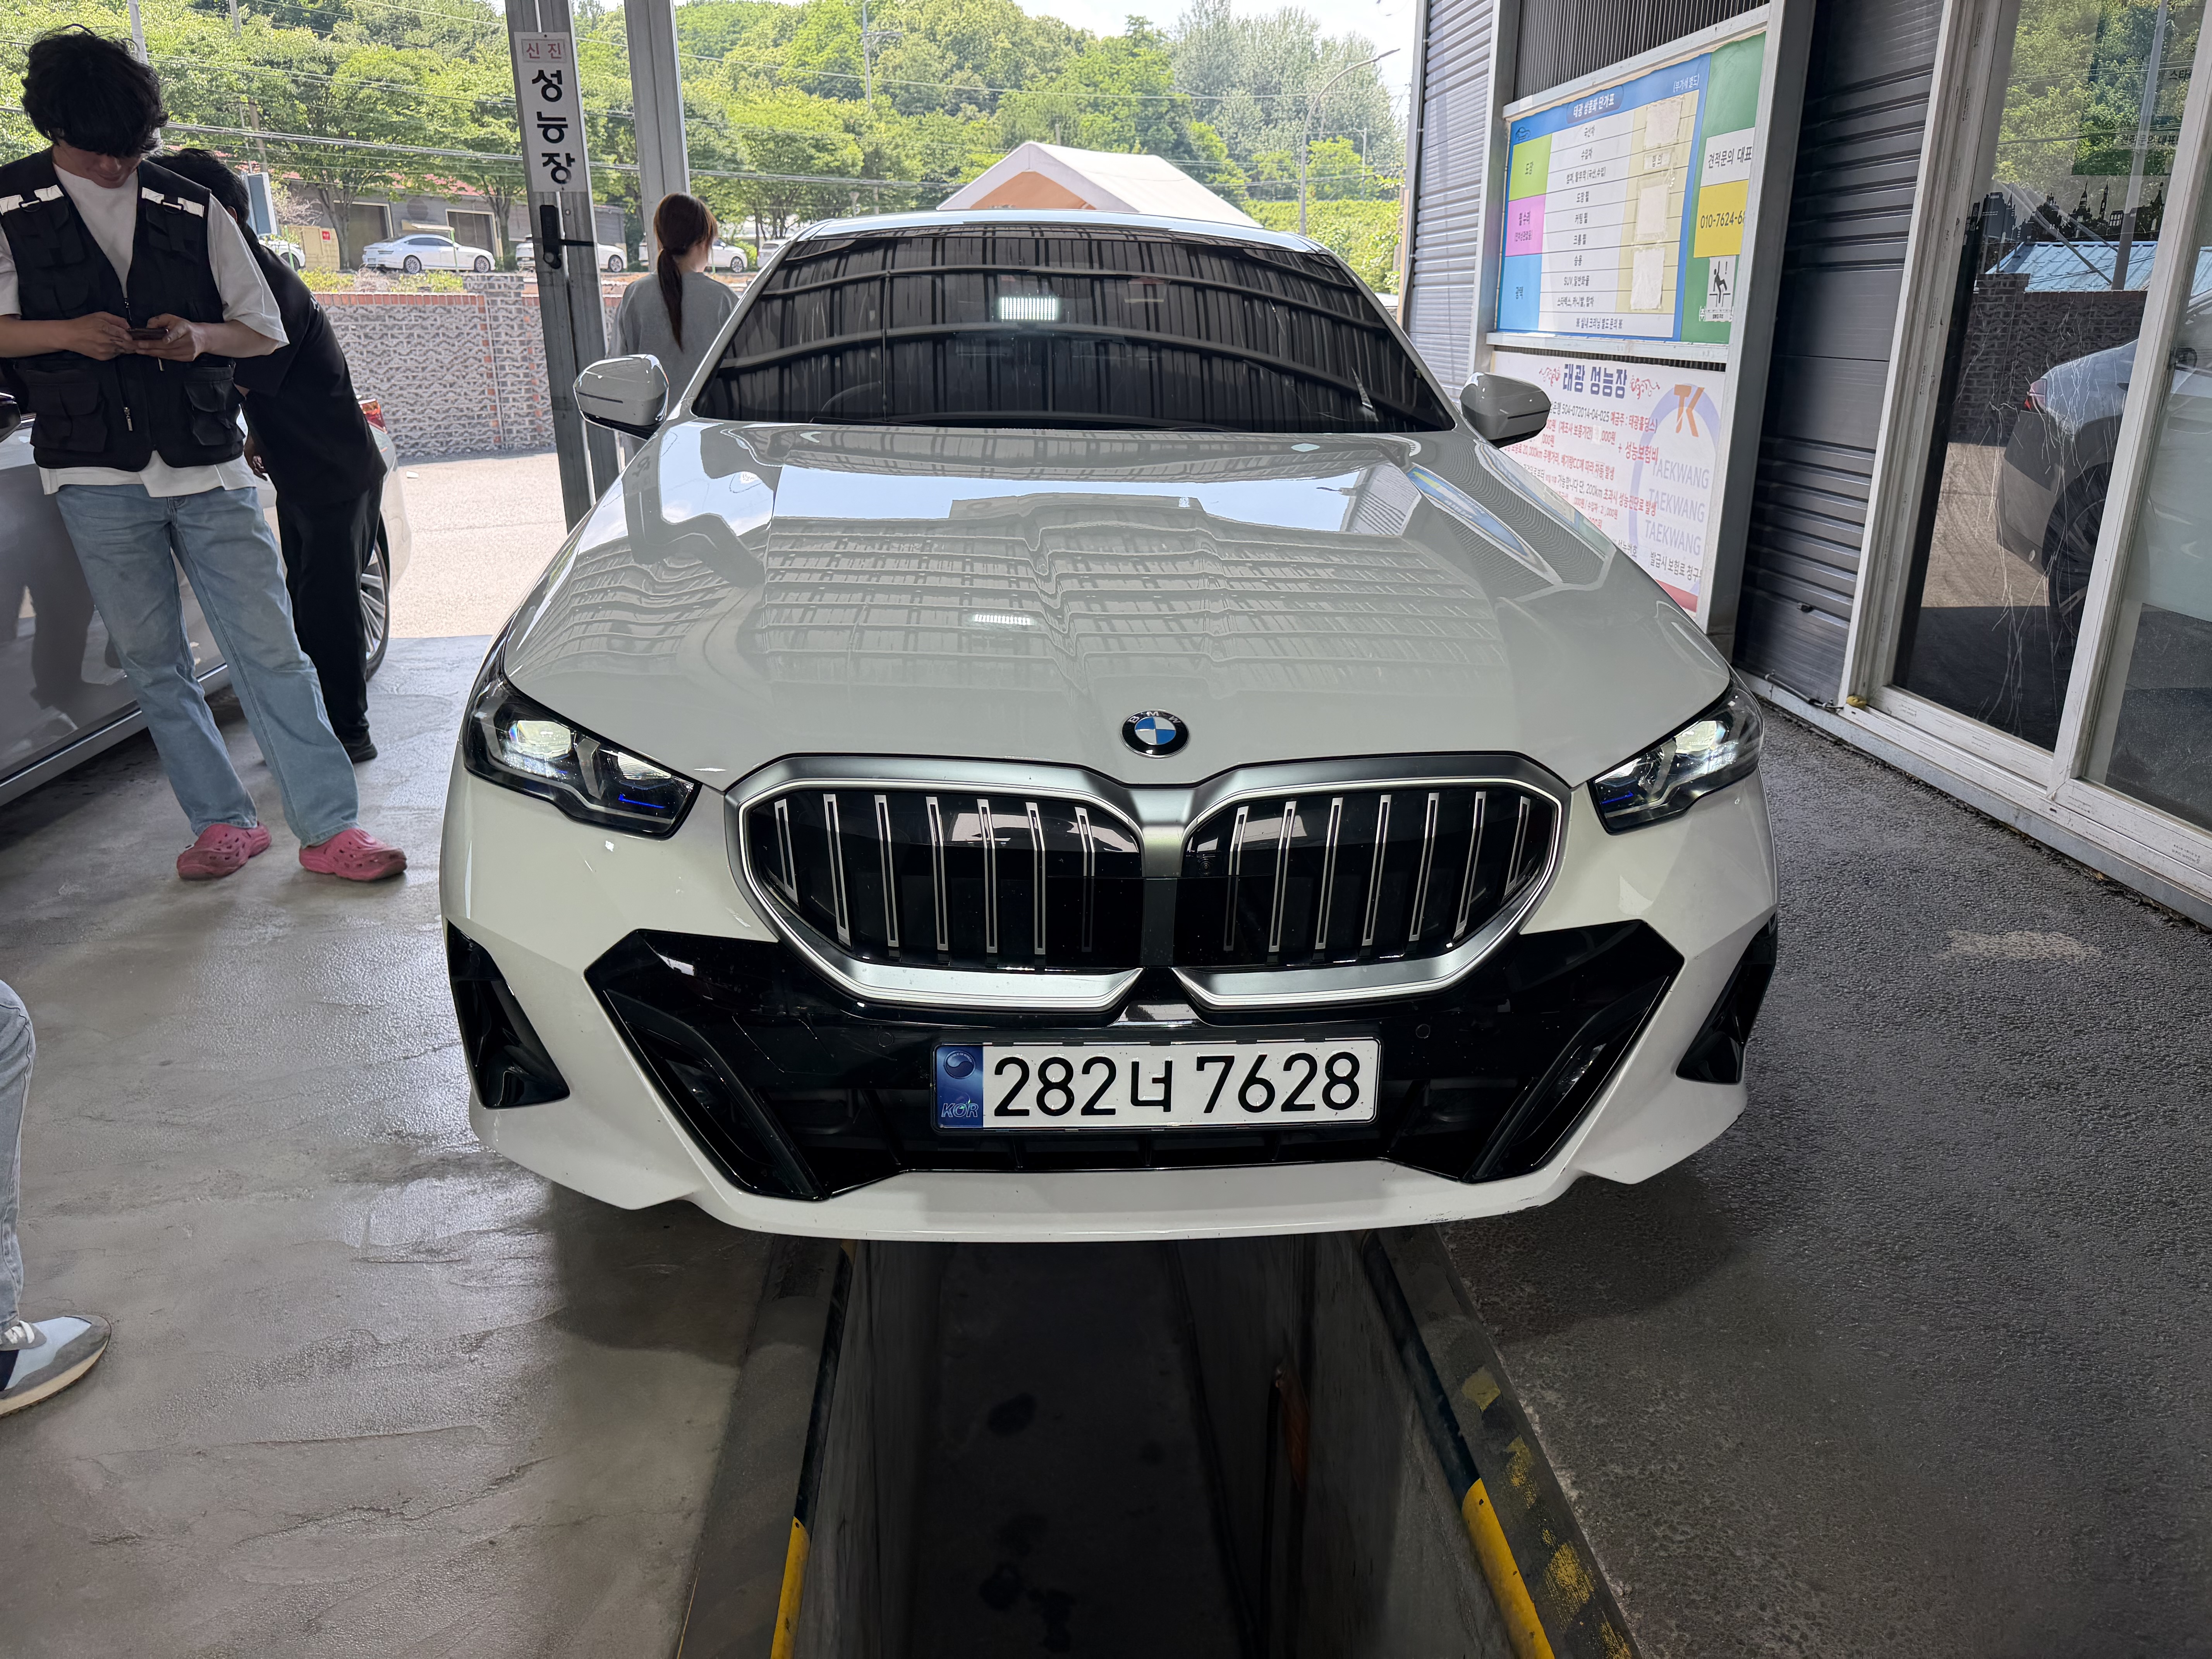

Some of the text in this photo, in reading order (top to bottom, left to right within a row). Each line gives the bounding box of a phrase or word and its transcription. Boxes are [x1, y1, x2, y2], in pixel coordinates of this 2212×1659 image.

[526, 43, 562, 59] 신진
[1573, 103, 1583, 118] 태광
[1599, 93, 1615, 110] 단가표
[532, 69, 575, 184] 성능장
[1708, 148, 1735, 169] 견적문의
[1563, 364, 1627, 399] 태광 성능장
[1549, 401, 1562, 415] 은행
[1610, 411, 1625, 427] 예금주
[1628, 414, 1658, 434] 태광홀딩스)
[1625, 441, 1659, 464] 성능보험비
[1605, 465, 1615, 481] 발생
[1652, 459, 1710, 489] TAEKWANG
[1586, 483, 1603, 498] 200km
[1603, 488, 1618, 505] 초과시
[1619, 493, 1644, 511] 성능진단료
[1645, 500, 1657, 517] 발생
[1649, 488, 1705, 523] TAEKWANG
[1645, 519, 1702, 556] TAEKWANG
[1650, 551, 1667, 570] 발급시
[1668, 558, 1685, 576] 보험료
[1128, 711, 1181, 724] BMW
[994, 1051, 1360, 1117] 282너 7628
[941, 1103, 979, 1118] KOR
